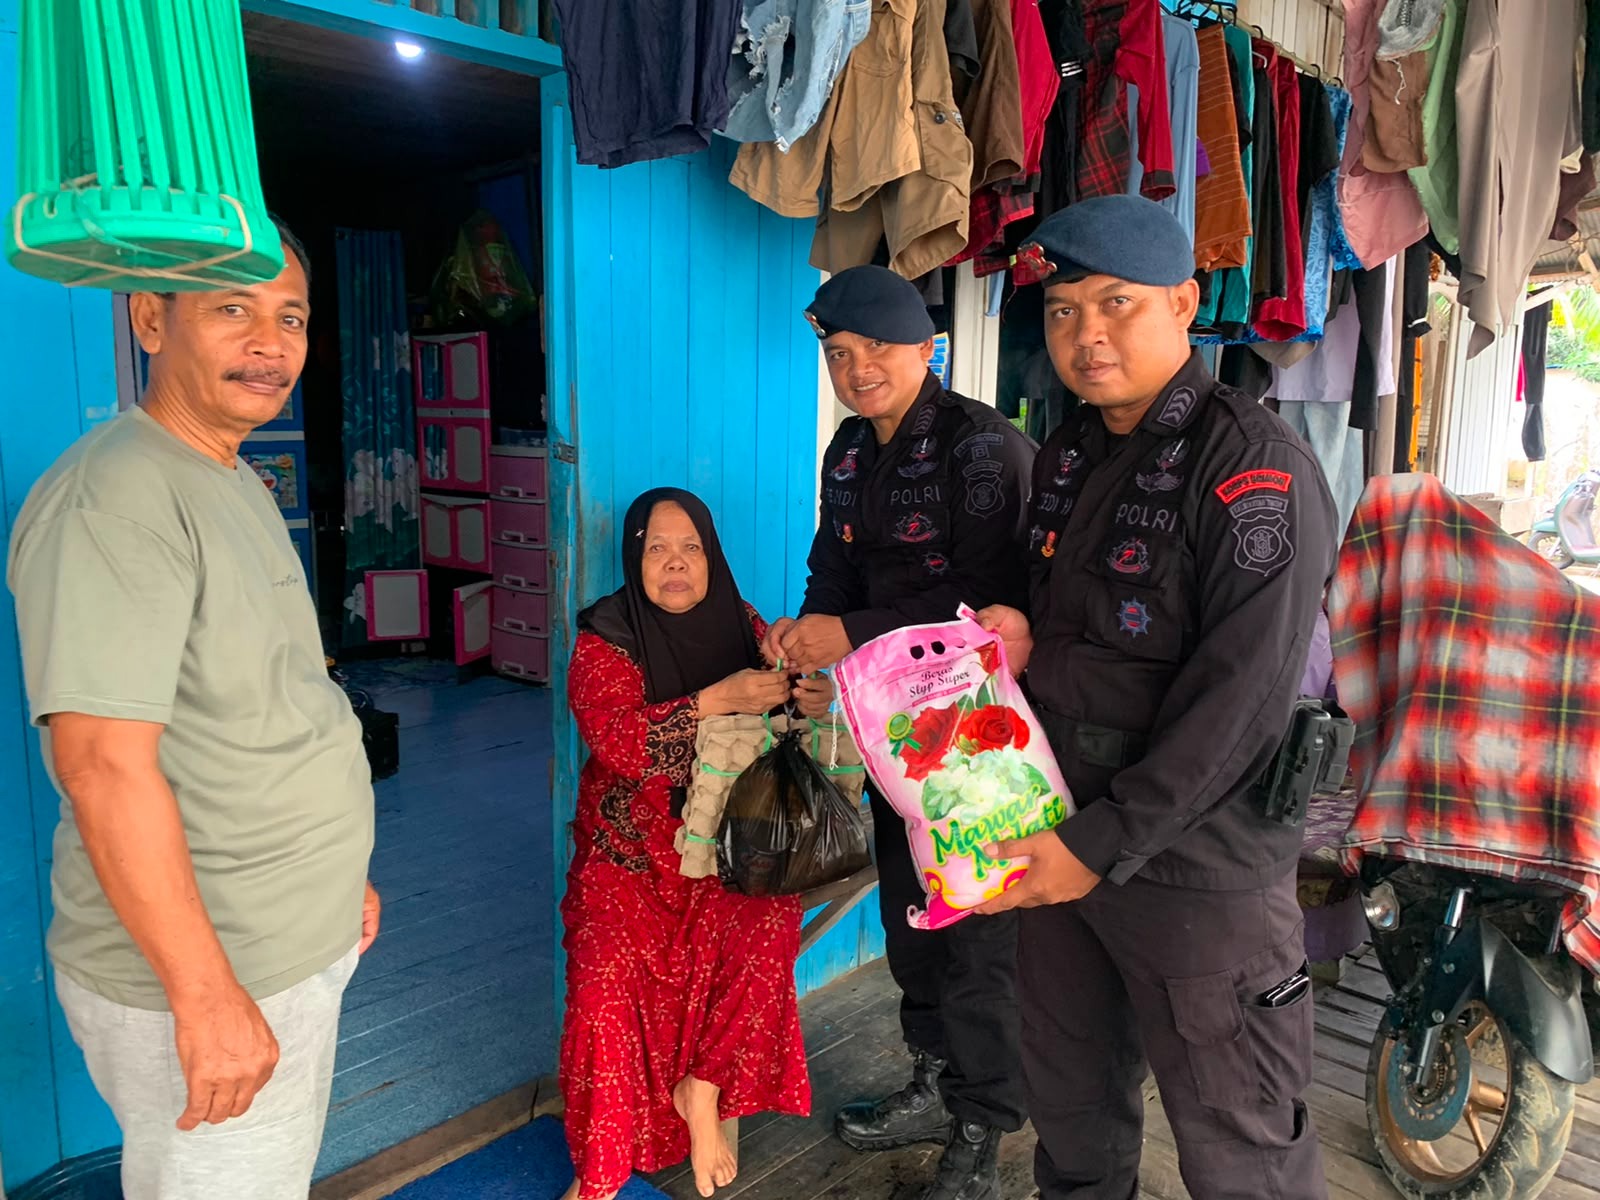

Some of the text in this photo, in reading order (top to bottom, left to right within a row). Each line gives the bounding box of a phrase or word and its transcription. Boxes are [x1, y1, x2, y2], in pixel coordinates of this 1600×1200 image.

[890, 484, 941, 507] POLRI
[1114, 503, 1178, 533] POLRI
[921, 666, 953, 682] Beras
[937, 671, 970, 686] Super
[929, 784, 1041, 866] Mawar
